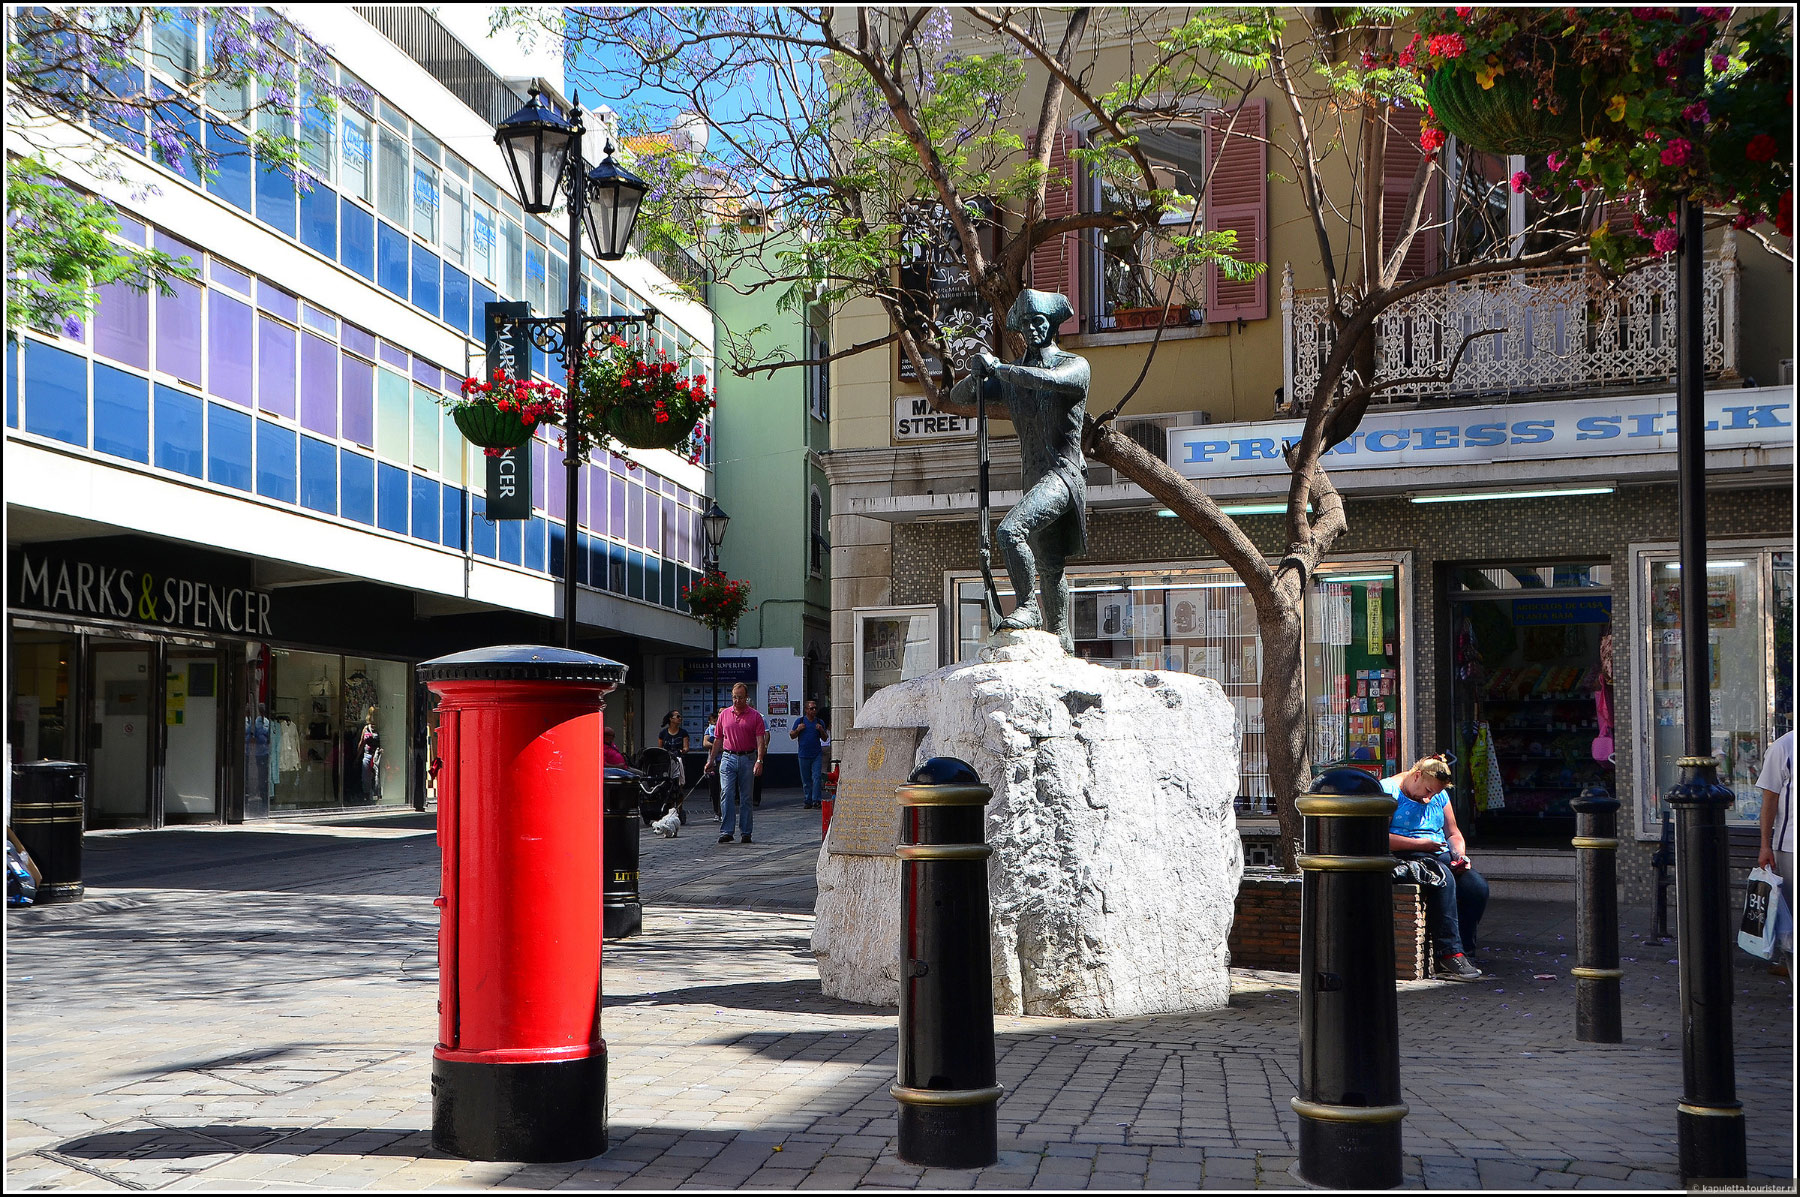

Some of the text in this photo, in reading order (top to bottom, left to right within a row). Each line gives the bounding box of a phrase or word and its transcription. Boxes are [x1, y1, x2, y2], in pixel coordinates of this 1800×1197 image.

[499, 323, 515, 498] MARK NCER
[899, 416, 969, 434] STREET
[20, 553, 273, 636] MARKS & SPENCER
[864, 660, 899, 670] ONDON
[616, 872, 640, 881] LITT
